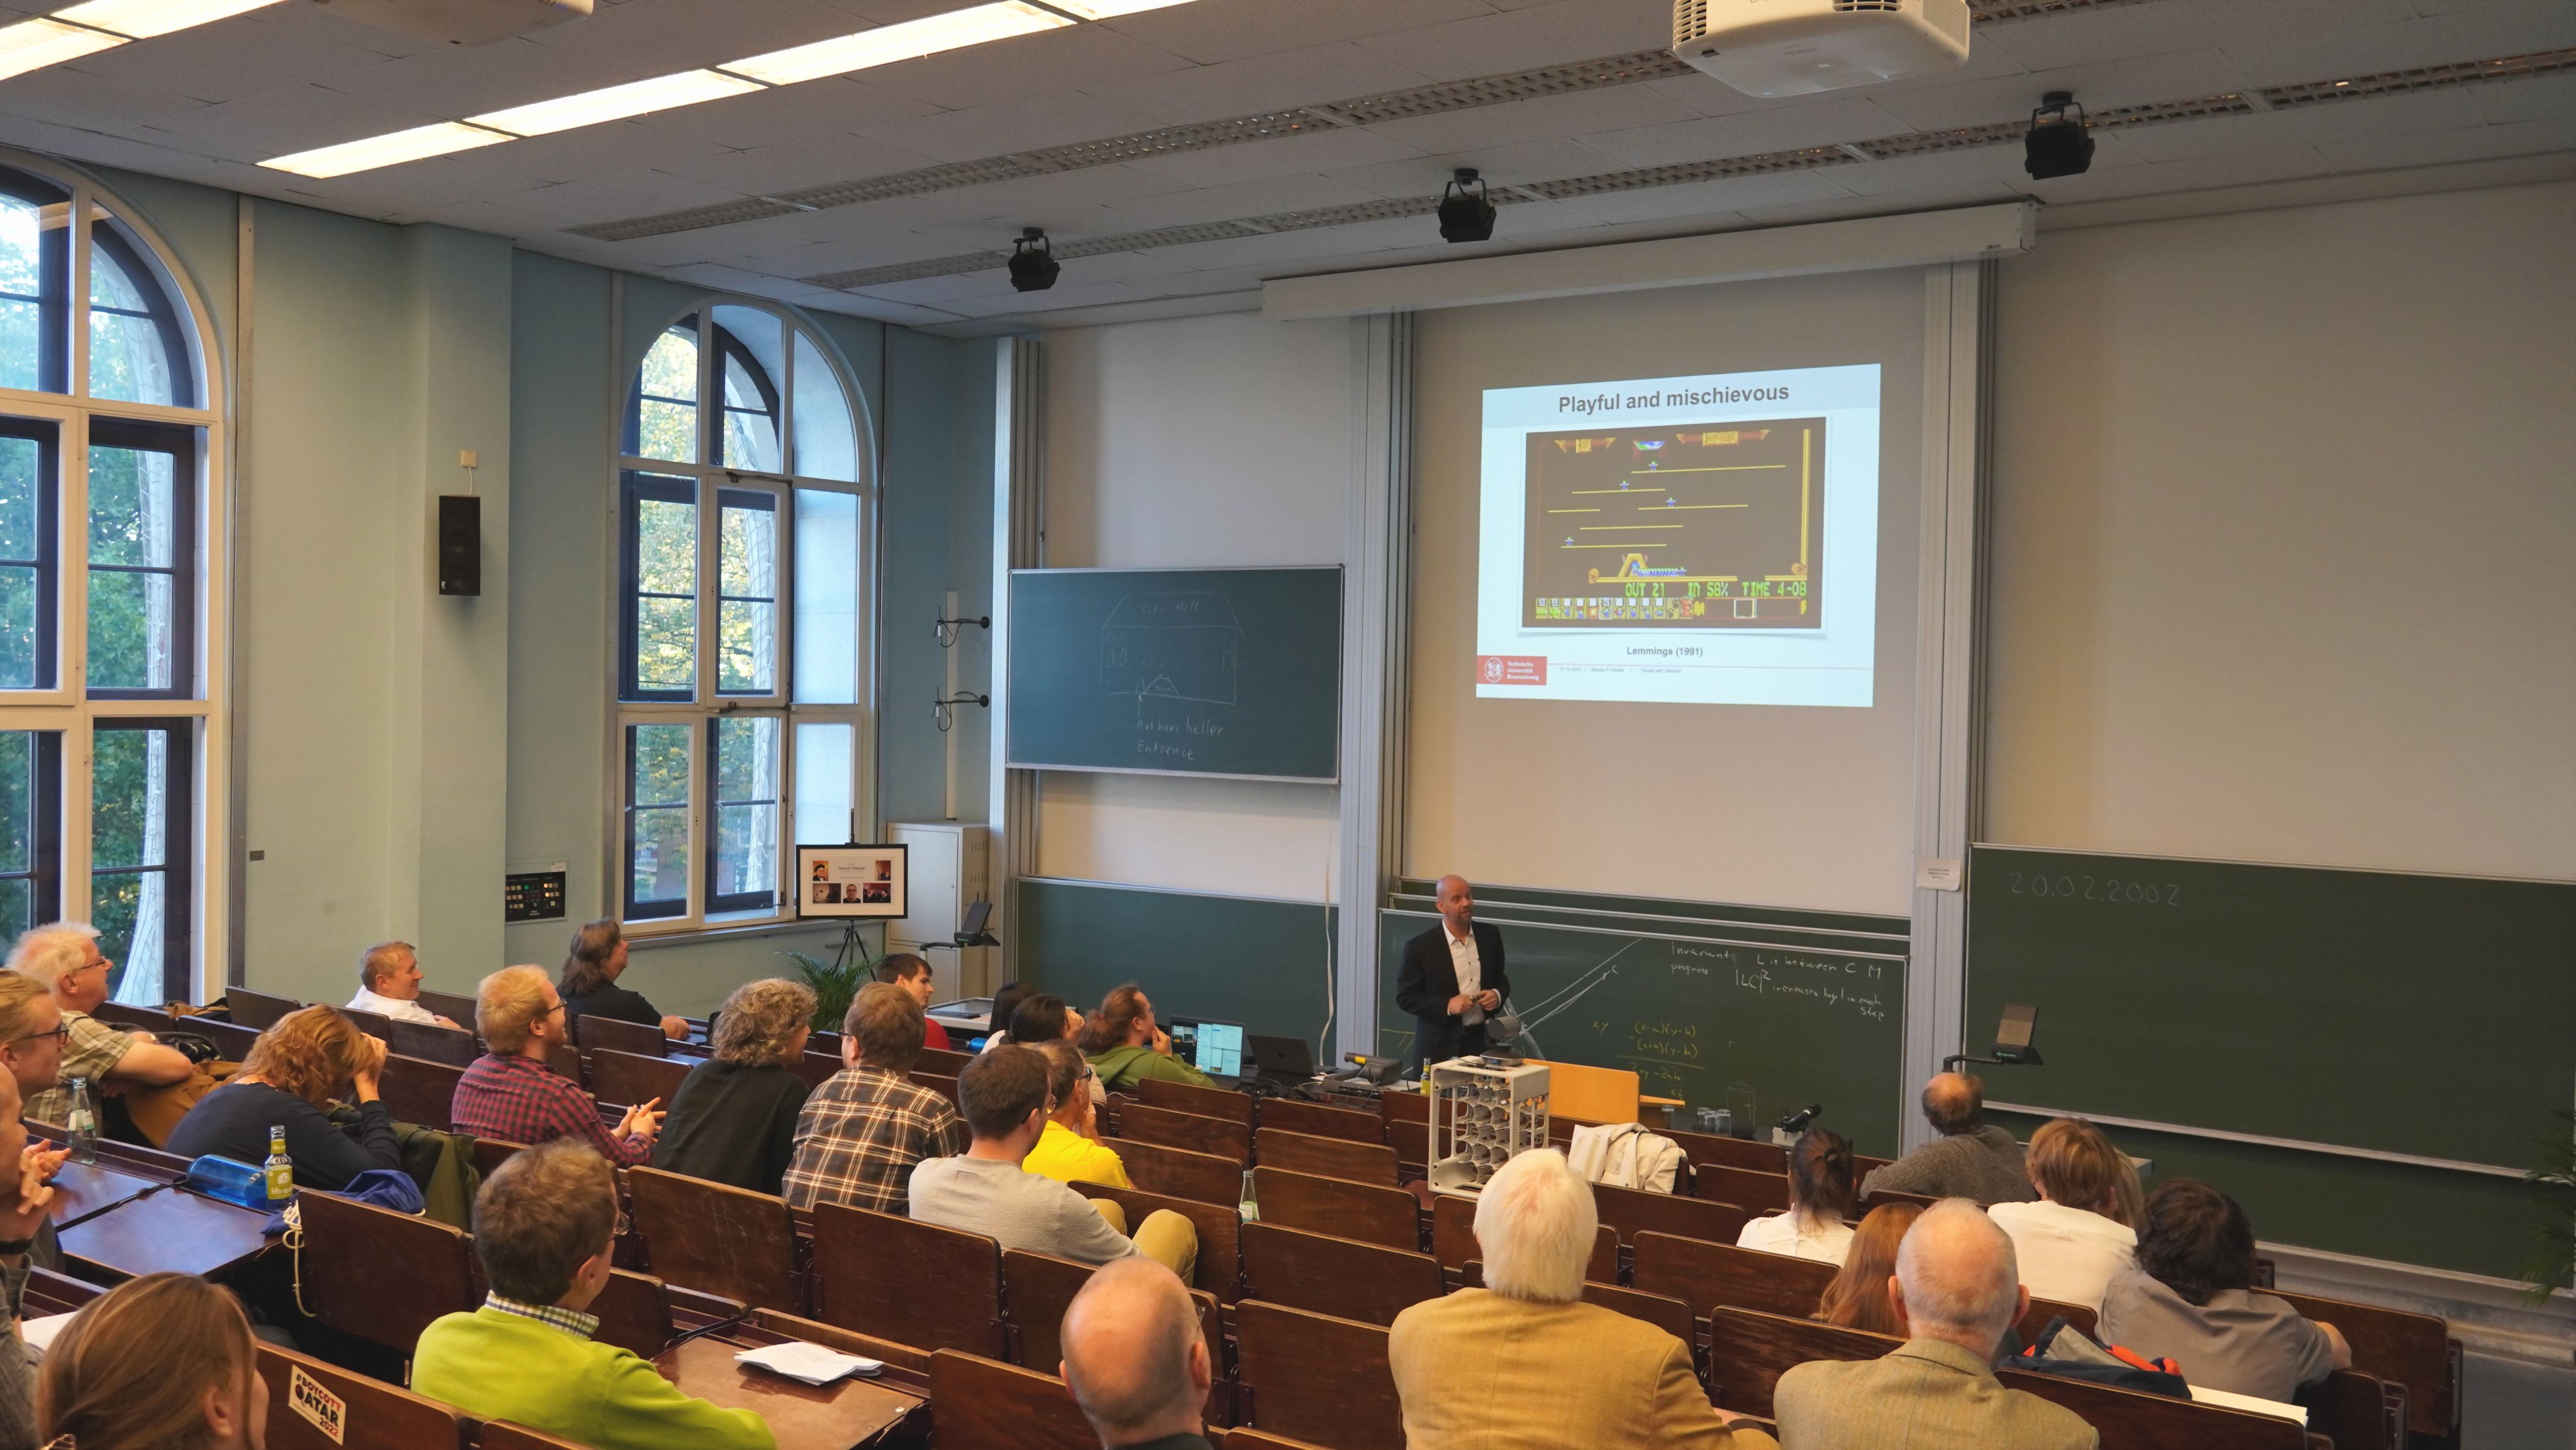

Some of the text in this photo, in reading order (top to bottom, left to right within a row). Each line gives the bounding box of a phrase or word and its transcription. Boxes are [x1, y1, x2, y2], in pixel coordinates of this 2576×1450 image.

[1559, 386, 1790, 415] Playful and mischievous
[1625, 583, 1646, 597] OUT
[1652, 583, 1665, 597] 21
[1707, 583, 1729, 597] 58%
[1741, 582, 1770, 596] TIME
[1626, 646, 1704, 657] Lemmings (1991)
[1784, 956, 1836, 972] between
[1845, 962, 1856, 973] C
[296, 1373, 341, 1412] #BOYCOTT
[295, 1384, 339, 1428] QATAR
[319, 1417, 339, 1438] 2022
